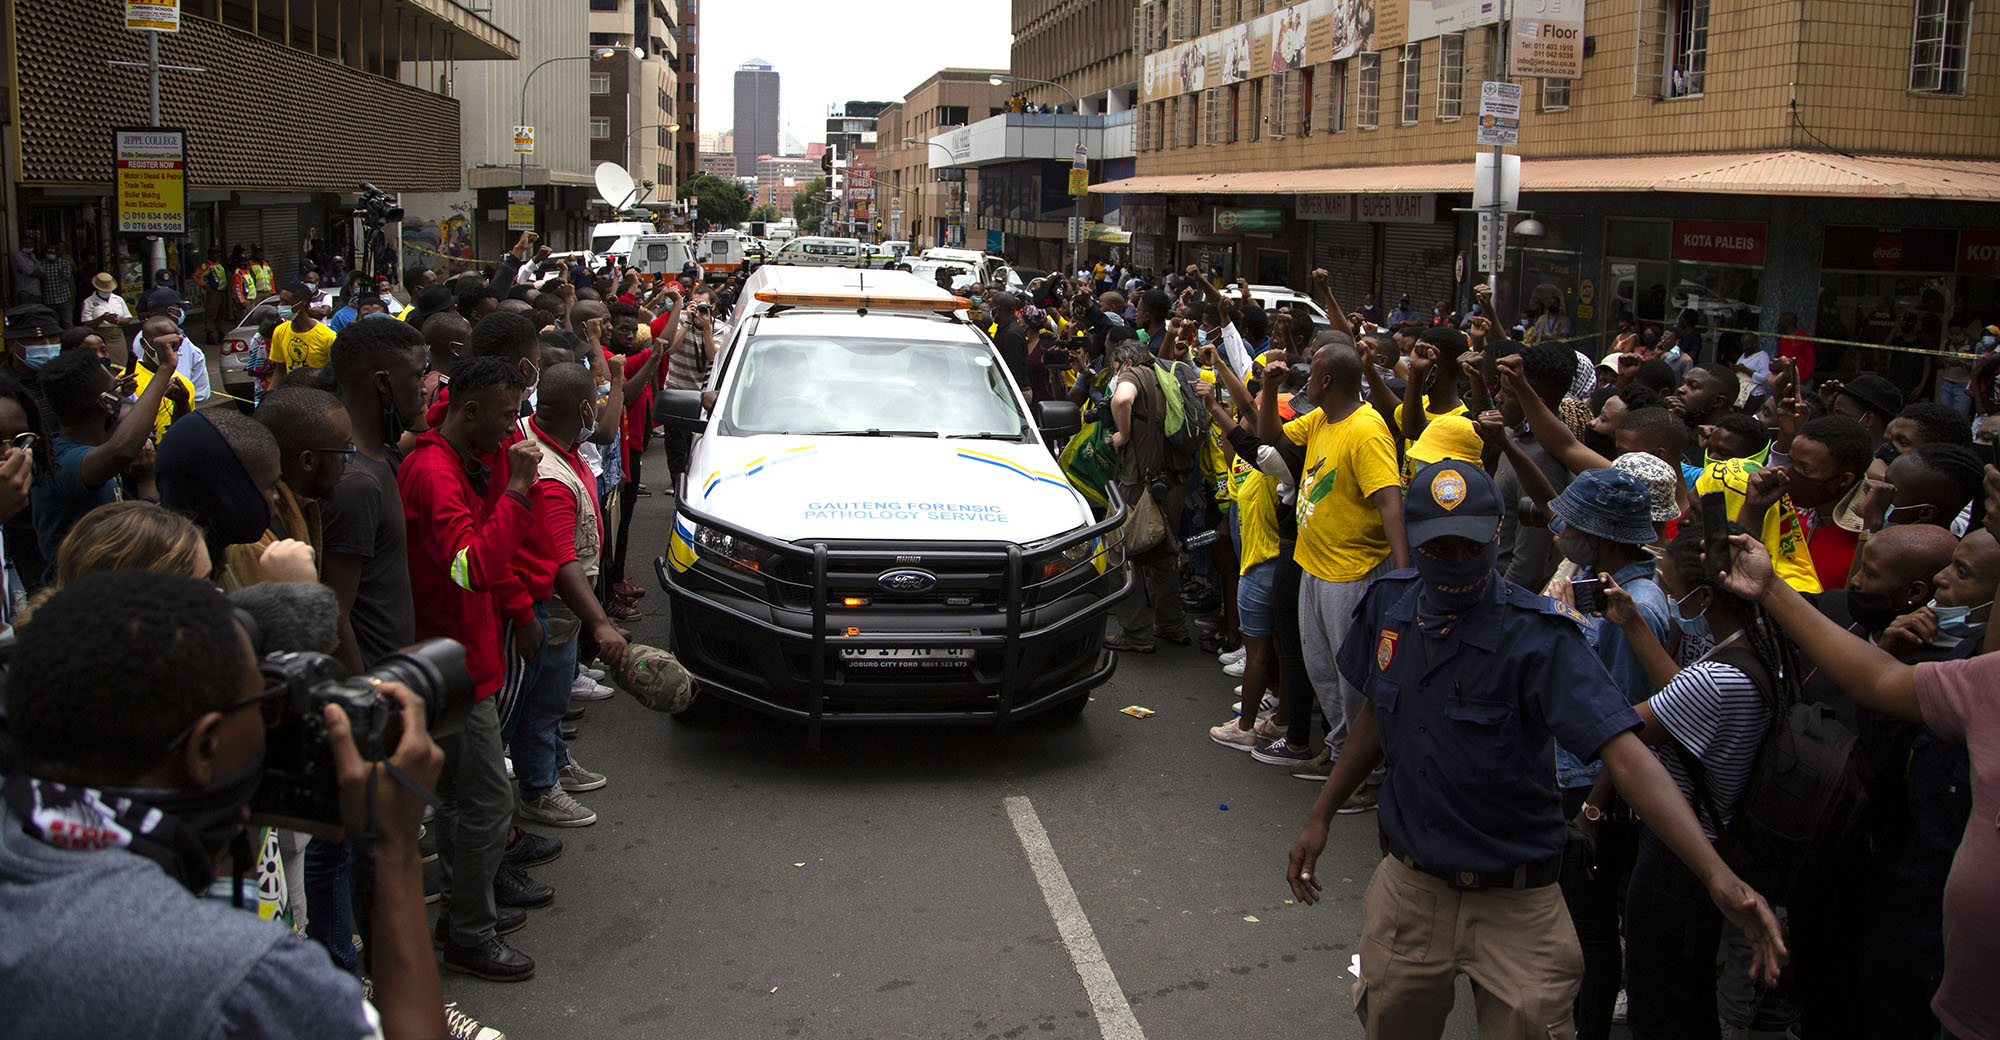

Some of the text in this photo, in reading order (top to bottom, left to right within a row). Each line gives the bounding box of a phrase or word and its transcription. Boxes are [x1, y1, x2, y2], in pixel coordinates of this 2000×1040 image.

[1543, 24, 1578, 39] Floor
[124, 136, 178, 145] JEPPE COLLEGE
[1299, 196, 1346, 214] SUPER MART
[1362, 195, 1423, 217] SUPER MART
[1481, 215, 1489, 270] BOSTON
[1683, 233, 1754, 250] KOTA PALEIS
[808, 502, 1002, 513] GAUTENG FORENSIC
[804, 510, 1009, 523] PATHOLOGY SERVICE
[896, 556, 921, 564] RHINO
[892, 574, 924, 590] Ford
